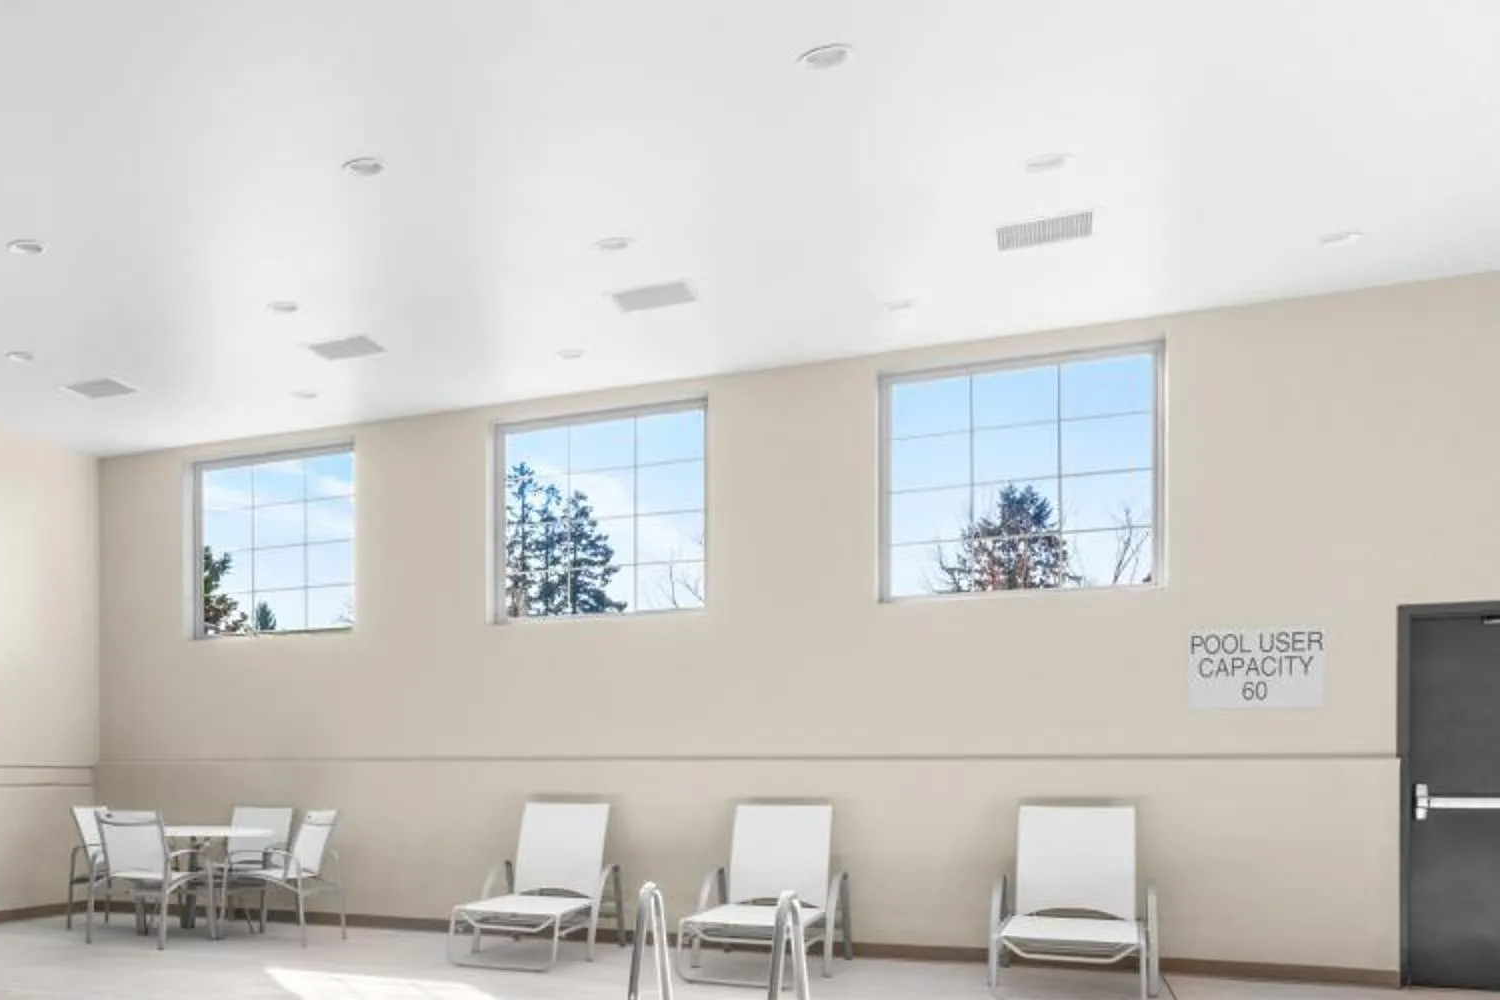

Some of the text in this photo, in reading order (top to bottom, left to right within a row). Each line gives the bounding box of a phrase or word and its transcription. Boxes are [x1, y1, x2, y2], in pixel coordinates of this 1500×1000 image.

[1191, 631, 1323, 654] POOL USER
[1199, 655, 1314, 678] CAPACITY
[1241, 681, 1268, 701] 60
